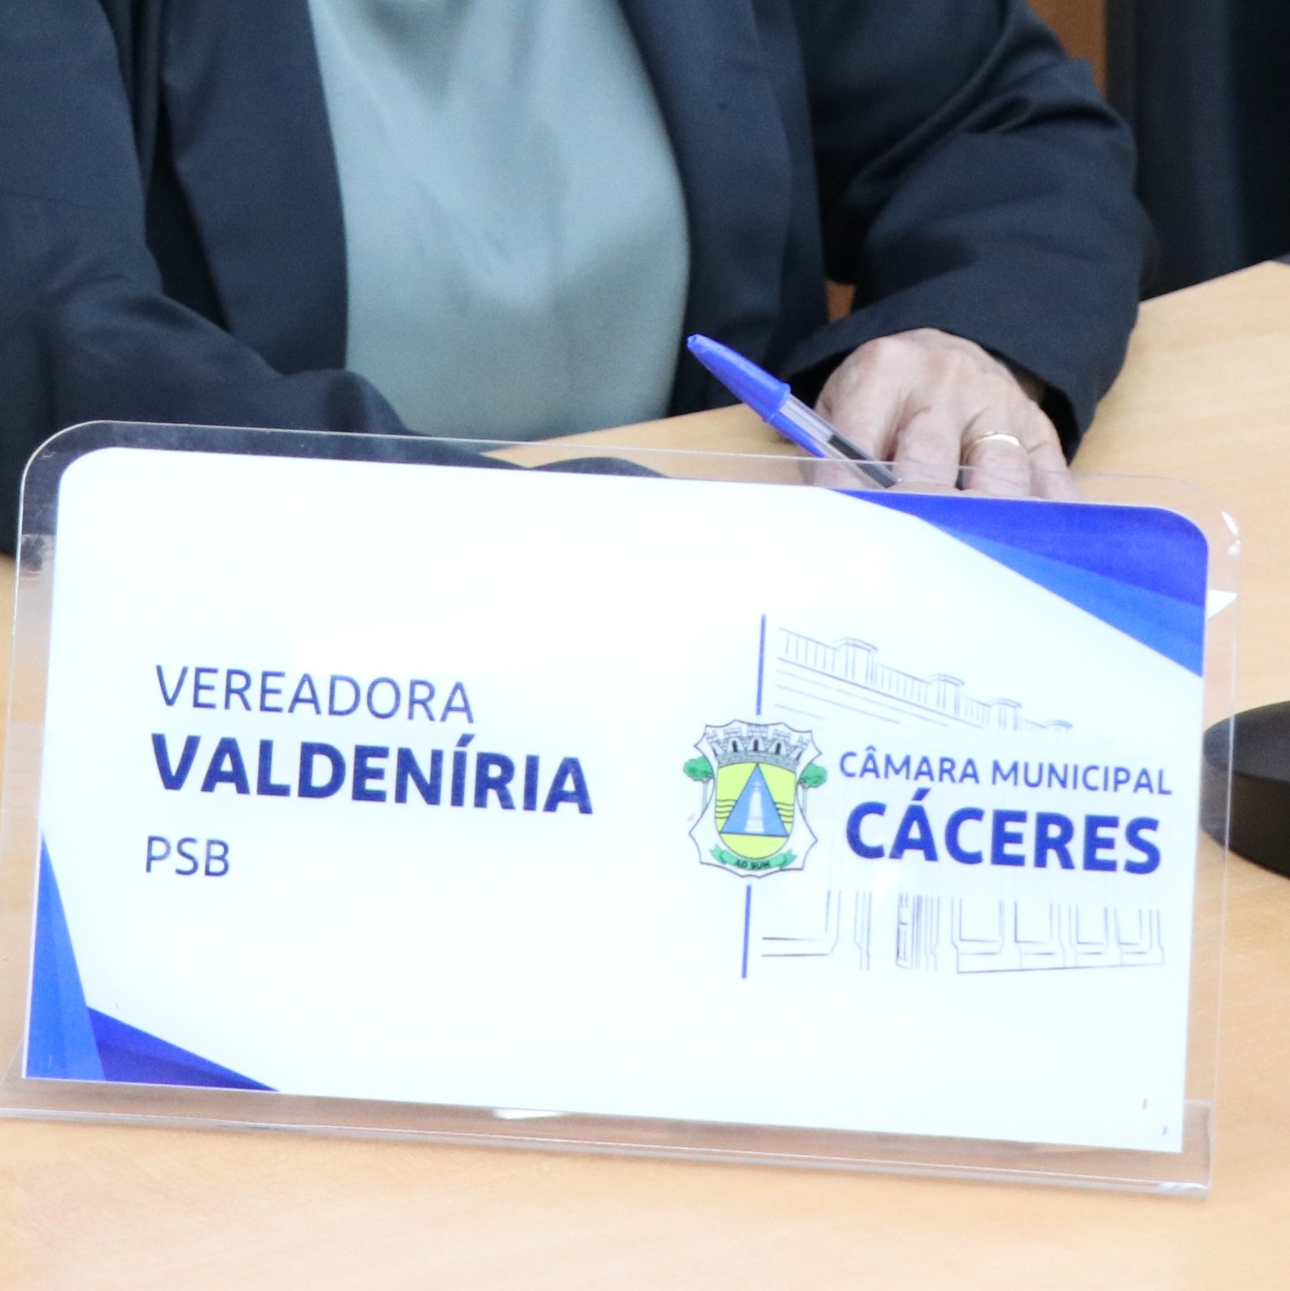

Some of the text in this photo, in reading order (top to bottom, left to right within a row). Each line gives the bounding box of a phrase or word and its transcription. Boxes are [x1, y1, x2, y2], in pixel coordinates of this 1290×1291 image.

[155, 664, 475, 726] VEREADORA
[150, 732, 594, 815] VALDENÍRIA
[839, 744, 1174, 797] CÂMARA MUNICIPAL
[145, 835, 231, 878] PSB
[845, 786, 1163, 876] CÁCERES
